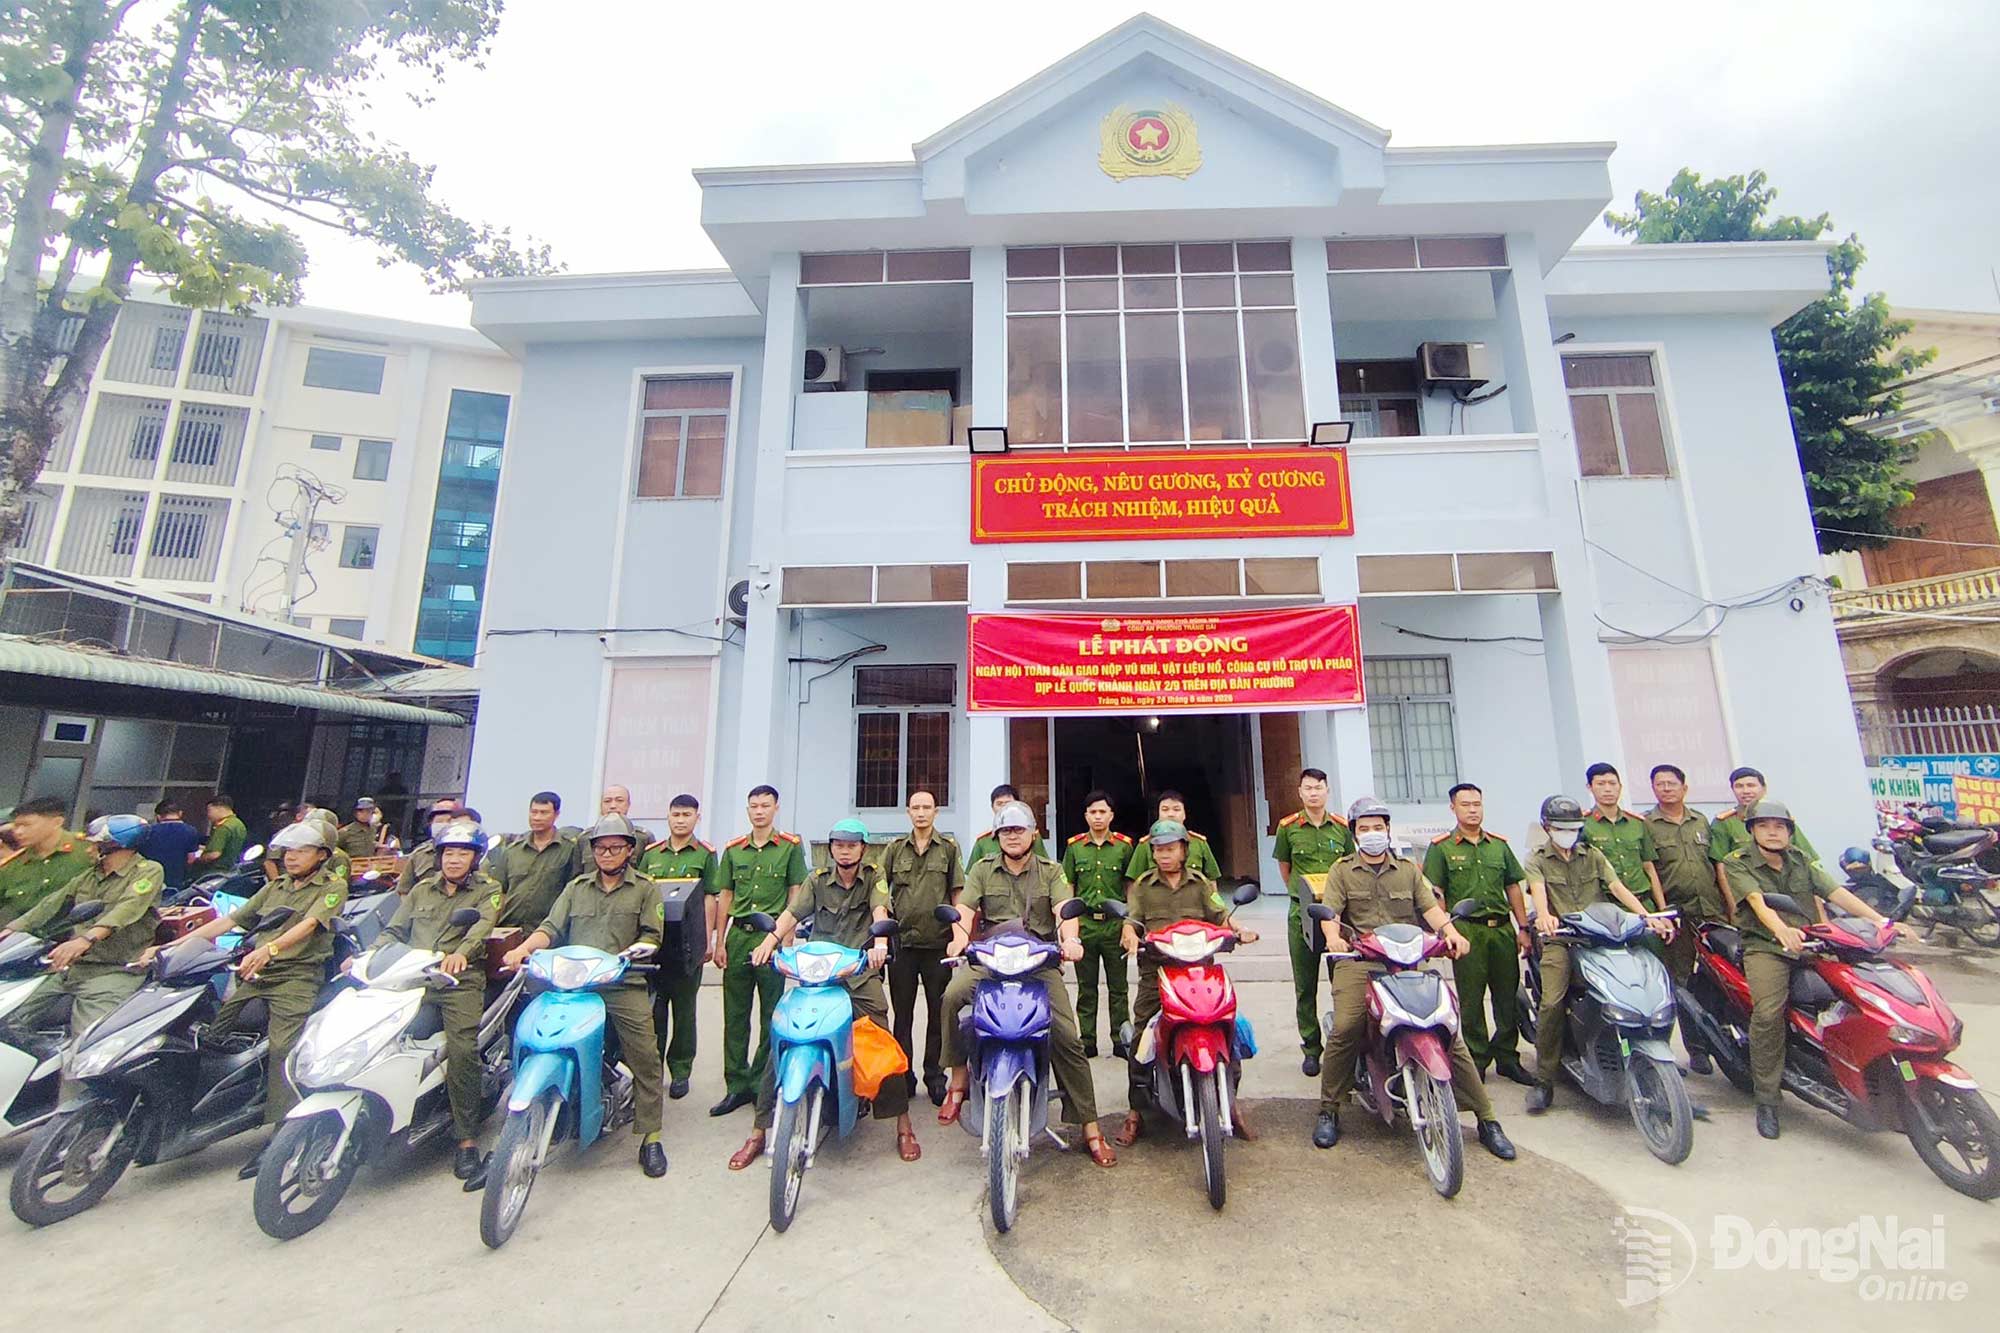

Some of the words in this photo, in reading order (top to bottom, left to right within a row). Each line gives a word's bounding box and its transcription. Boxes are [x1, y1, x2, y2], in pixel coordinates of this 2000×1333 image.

[994, 472, 1034, 494] CHỦ
[1039, 473, 1098, 496] ĐỘNG,
[1103, 472, 1144, 492] NÊU
[1149, 472, 1221, 492] GƯƠNG,
[1226, 467, 1253, 489] KỶ
[1258, 470, 1326, 488] CƯƠNG
[1042, 498, 1108, 519] TRÁCH
[1112, 496, 1182, 520] NHIỆM,
[1186, 495, 1235, 519] HIỆU
[1240, 492, 1281, 517] QUẢ
[1079, 634, 1104, 655] LỄ
[1110, 635, 1170, 655] PHÁT
[1176, 634, 1248, 657] ĐỘNG
[976, 664, 1002, 677] NGÀY
[1005, 664, 1021, 678] HỘI
[1076, 665, 1099, 676] GIAO
[1101, 662, 1122, 677] NỘP
[1124, 662, 1138, 675] VŨ
[1162, 661, 1181, 676] VẬT
[1183, 661, 1205, 676] LIỆU
[1227, 660, 1254, 673] CÔNG
[1256, 660, 1270, 674] CỤ
[1288, 658, 1308, 673] TRỢ
[1309, 657, 1323, 670] VÀ
[1325, 656, 1352, 670] PHÁO
[1035, 681, 1052, 695] DỊP
[1069, 679, 1096, 693] QUỐC
[1098, 679, 1132, 692] KHÁNH
[1135, 678, 1161, 692] NGÀY
[1164, 680, 1180, 691] 2/9
[1182, 677, 1208, 691] TRÊN
[1210, 679, 1228, 692] ĐỊA
[1229, 677, 1251, 690] BÀN
